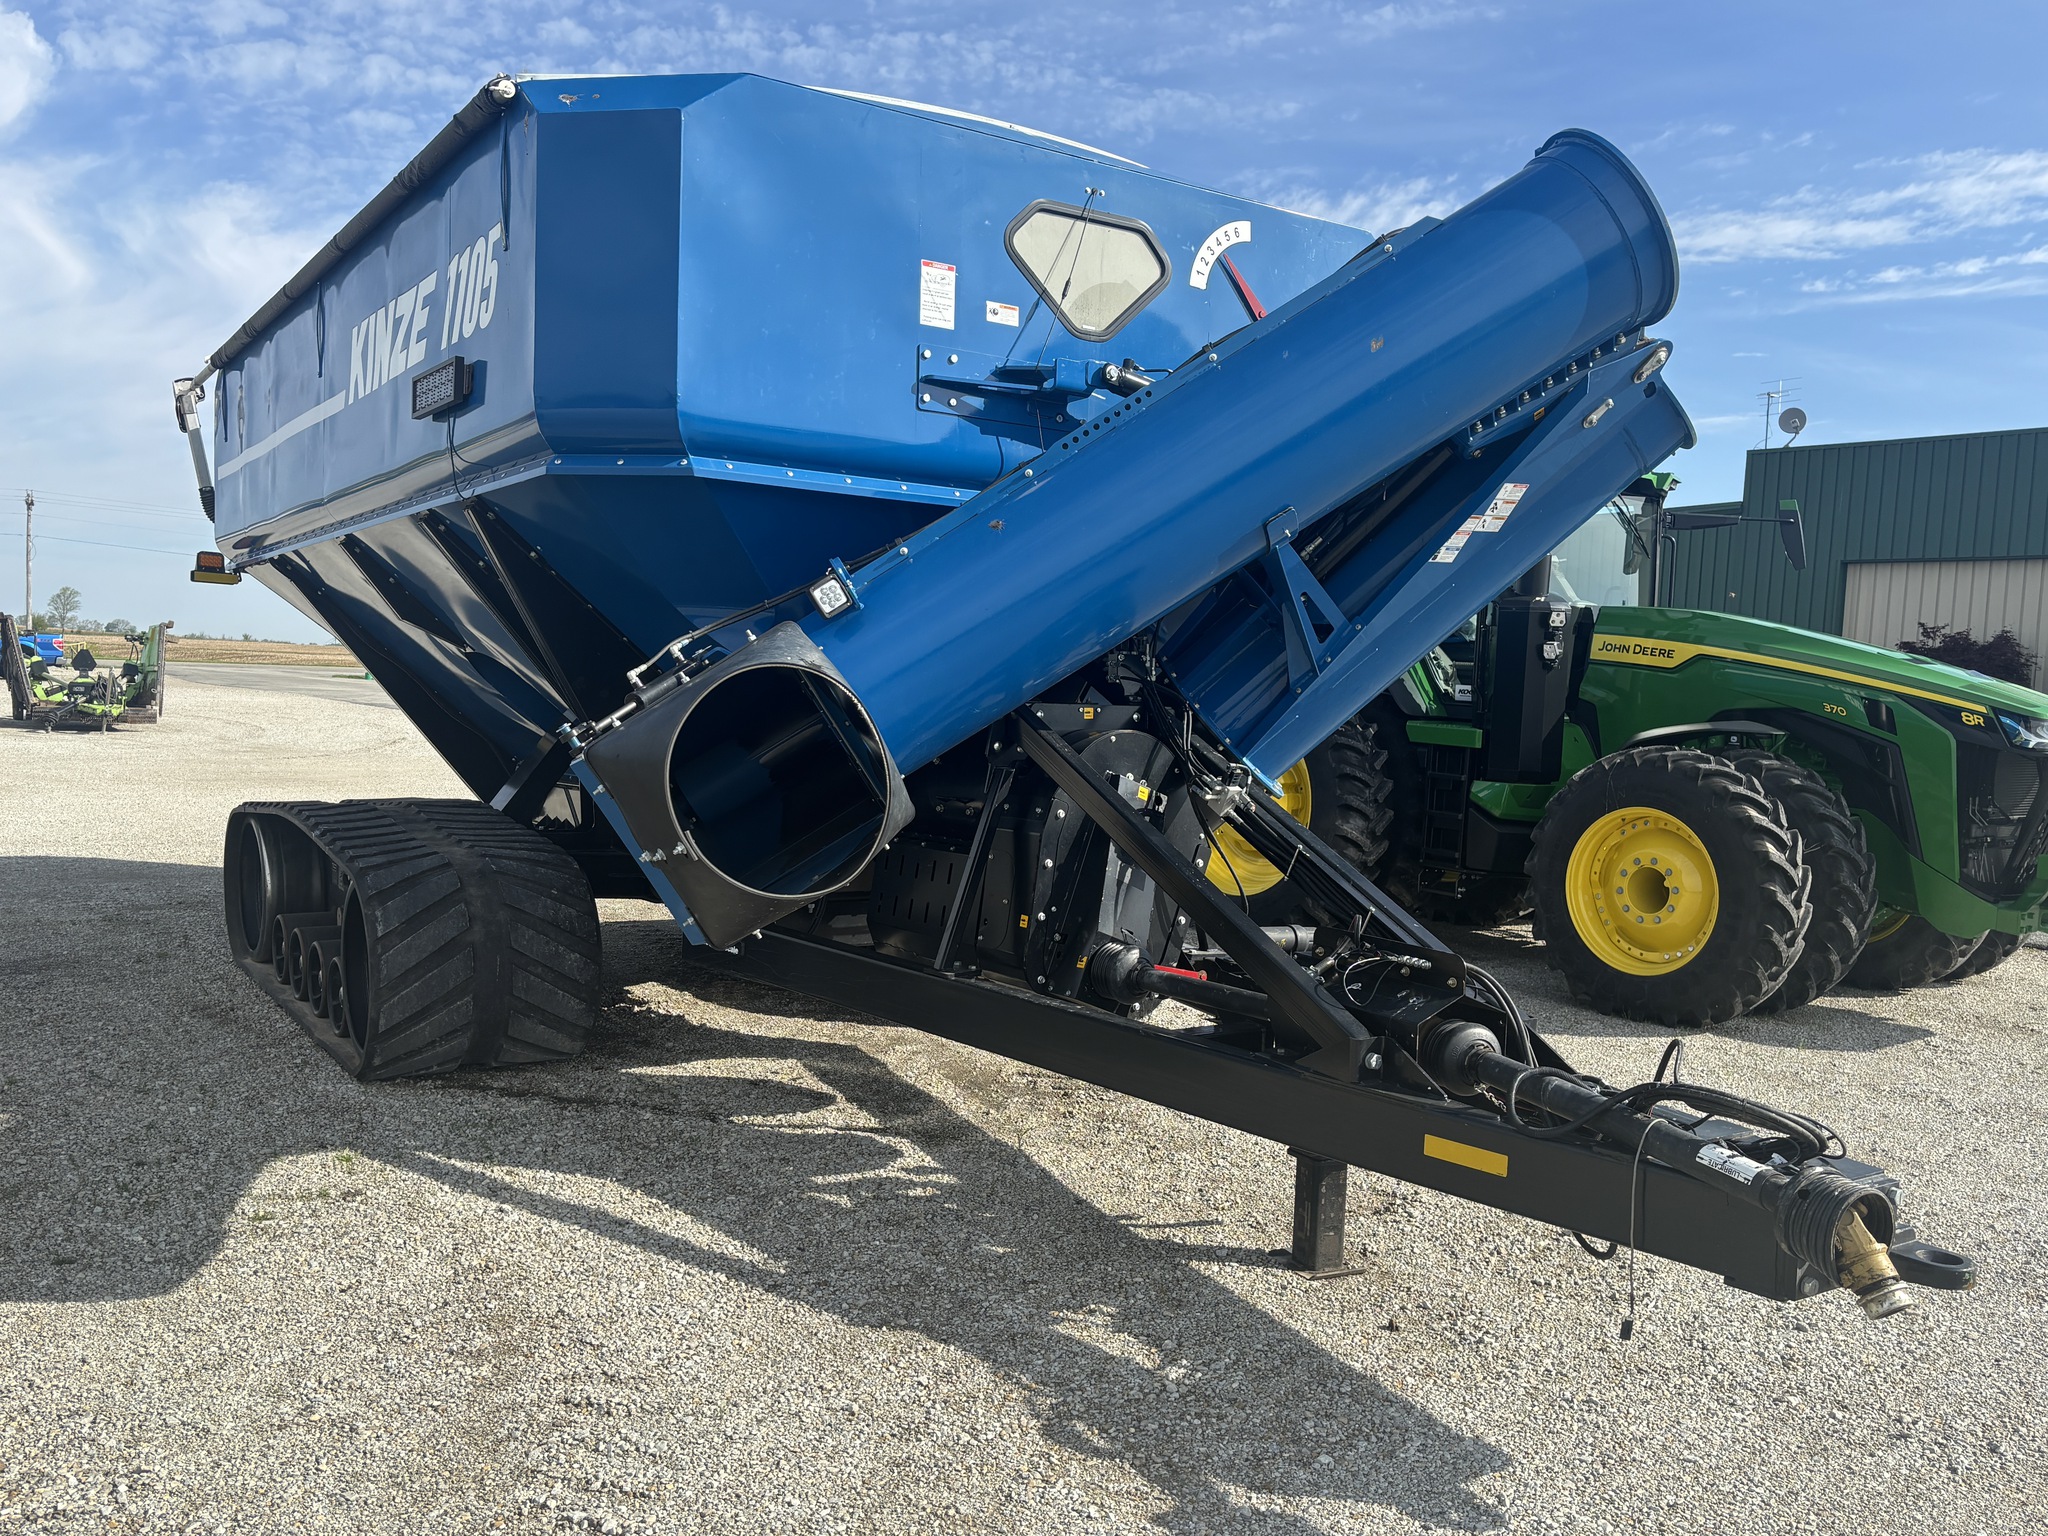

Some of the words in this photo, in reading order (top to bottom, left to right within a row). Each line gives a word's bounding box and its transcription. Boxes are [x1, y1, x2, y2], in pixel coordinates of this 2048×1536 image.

[1200, 256, 1209, 267] 2
[1207, 245, 1215, 256] 3
[1215, 236, 1222, 247] 4
[1224, 230, 1231, 242] 5
[1234, 226, 1240, 239] 6
[348, 270, 438, 405] KINZE
[441, 221, 501, 350] 1105
[1598, 640, 1631, 654] JOHN
[1632, 643, 1675, 659] DEERE
[1822, 702, 1847, 716] 370
[1960, 711, 1985, 727] 8R
[1706, 1158, 1741, 1179] LUBRICATE
